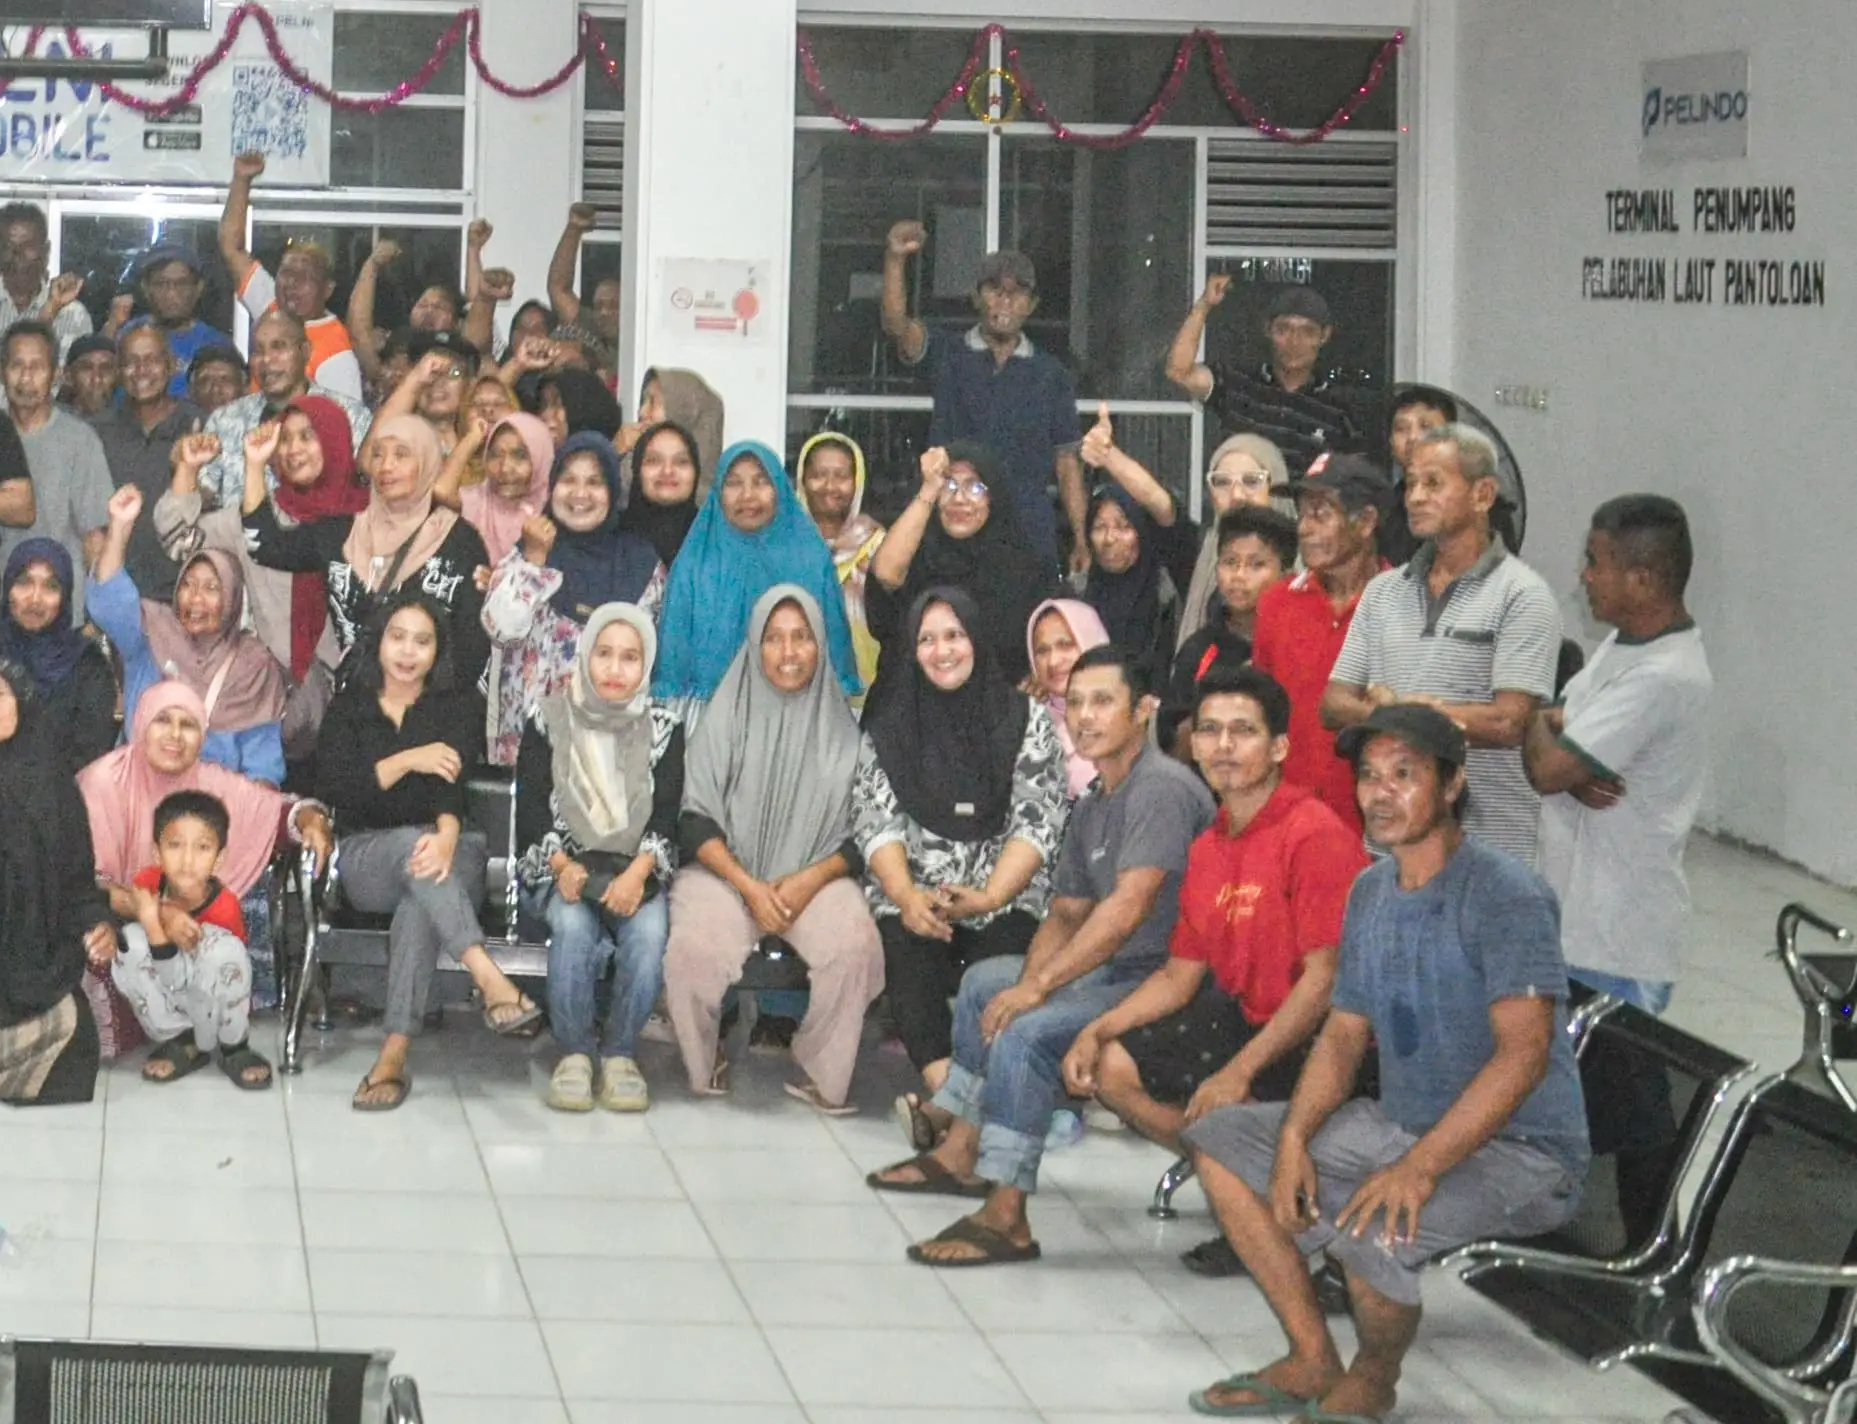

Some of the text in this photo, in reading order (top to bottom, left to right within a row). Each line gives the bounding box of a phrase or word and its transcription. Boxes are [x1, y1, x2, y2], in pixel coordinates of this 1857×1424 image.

[1664, 91, 1748, 125] PELINDO
[1605, 186, 1796, 234] TERMINAL PENUMPANG
[1582, 257, 1825, 307] PELABUHAN LAUT PANTOLOAN
